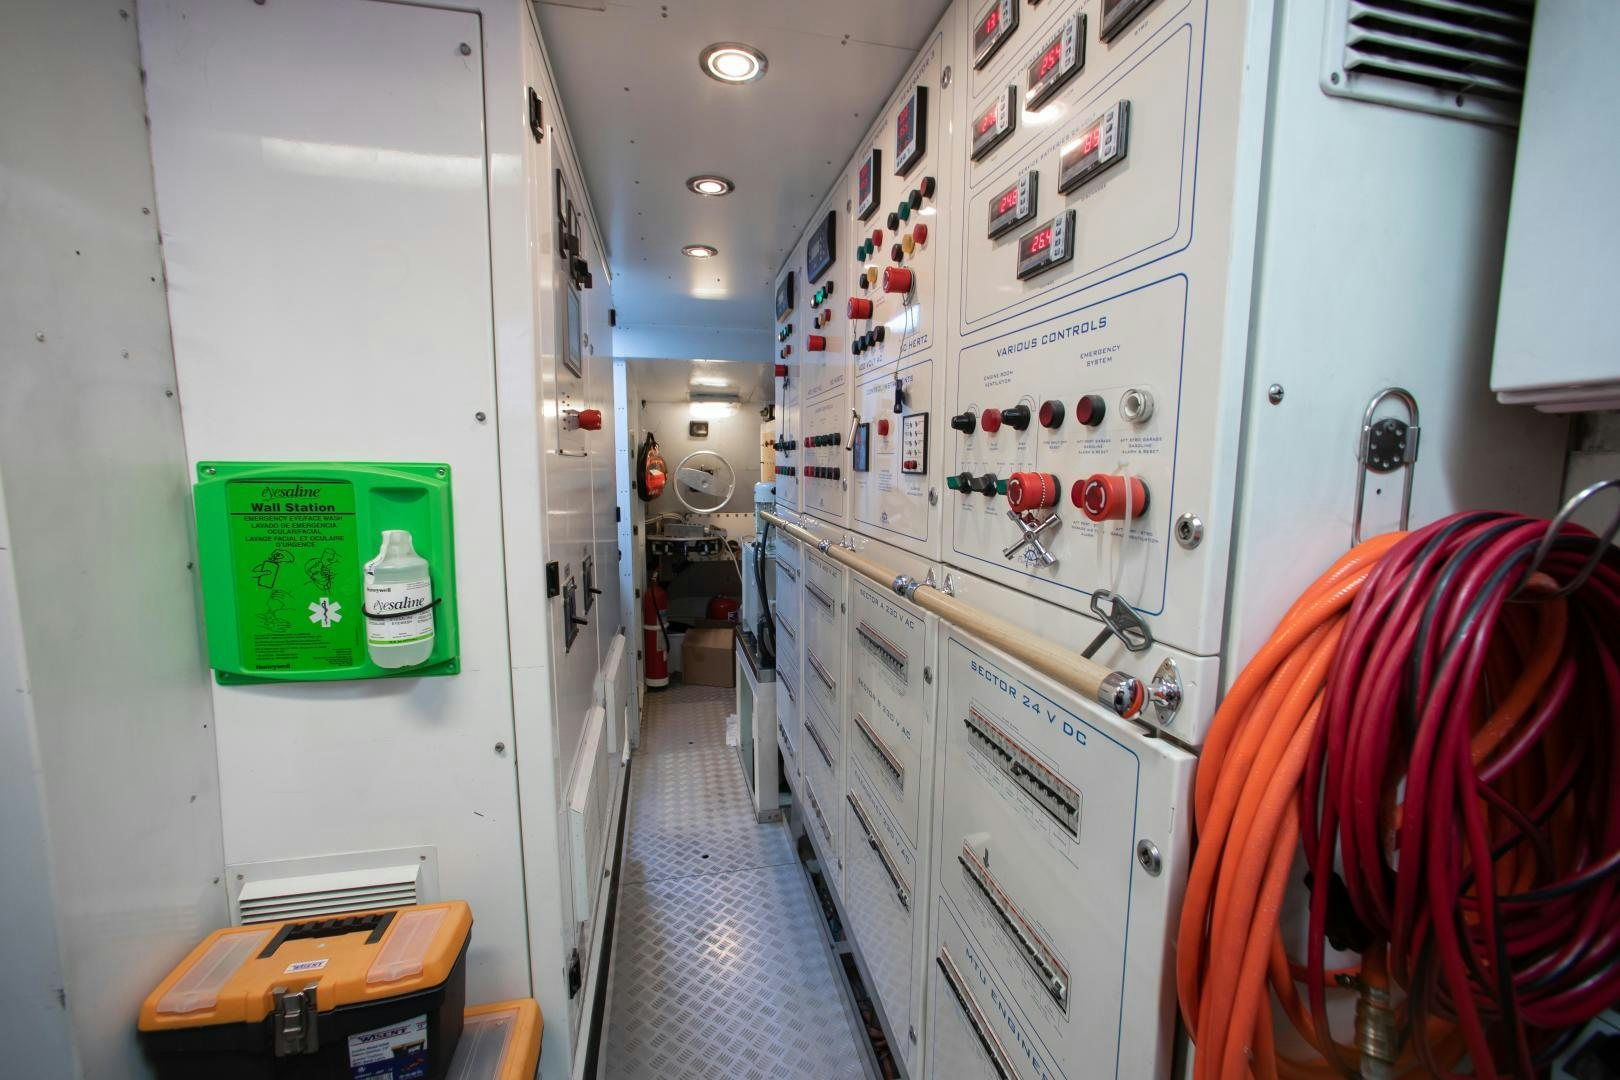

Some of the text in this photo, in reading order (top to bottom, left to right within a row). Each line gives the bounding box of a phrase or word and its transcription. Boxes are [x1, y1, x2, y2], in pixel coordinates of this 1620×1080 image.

[908, 334, 928, 350] HERTZ
[996, 316, 1108, 358] VARIOUS CONTROLS
[1080, 344, 1121, 359] EMERGENCY
[1086, 356, 1113, 367] SYSTEM
[983, 373, 999, 381] ENGINE
[251, 502, 336, 512] Wall Station
[373, 596, 425, 613] eyesaline
[885, 604, 898, 618] 230
[904, 617, 915, 631] AC
[971, 660, 1087, 746] SECTOR 24 V DC
[965, 947, 986, 985] MTU
